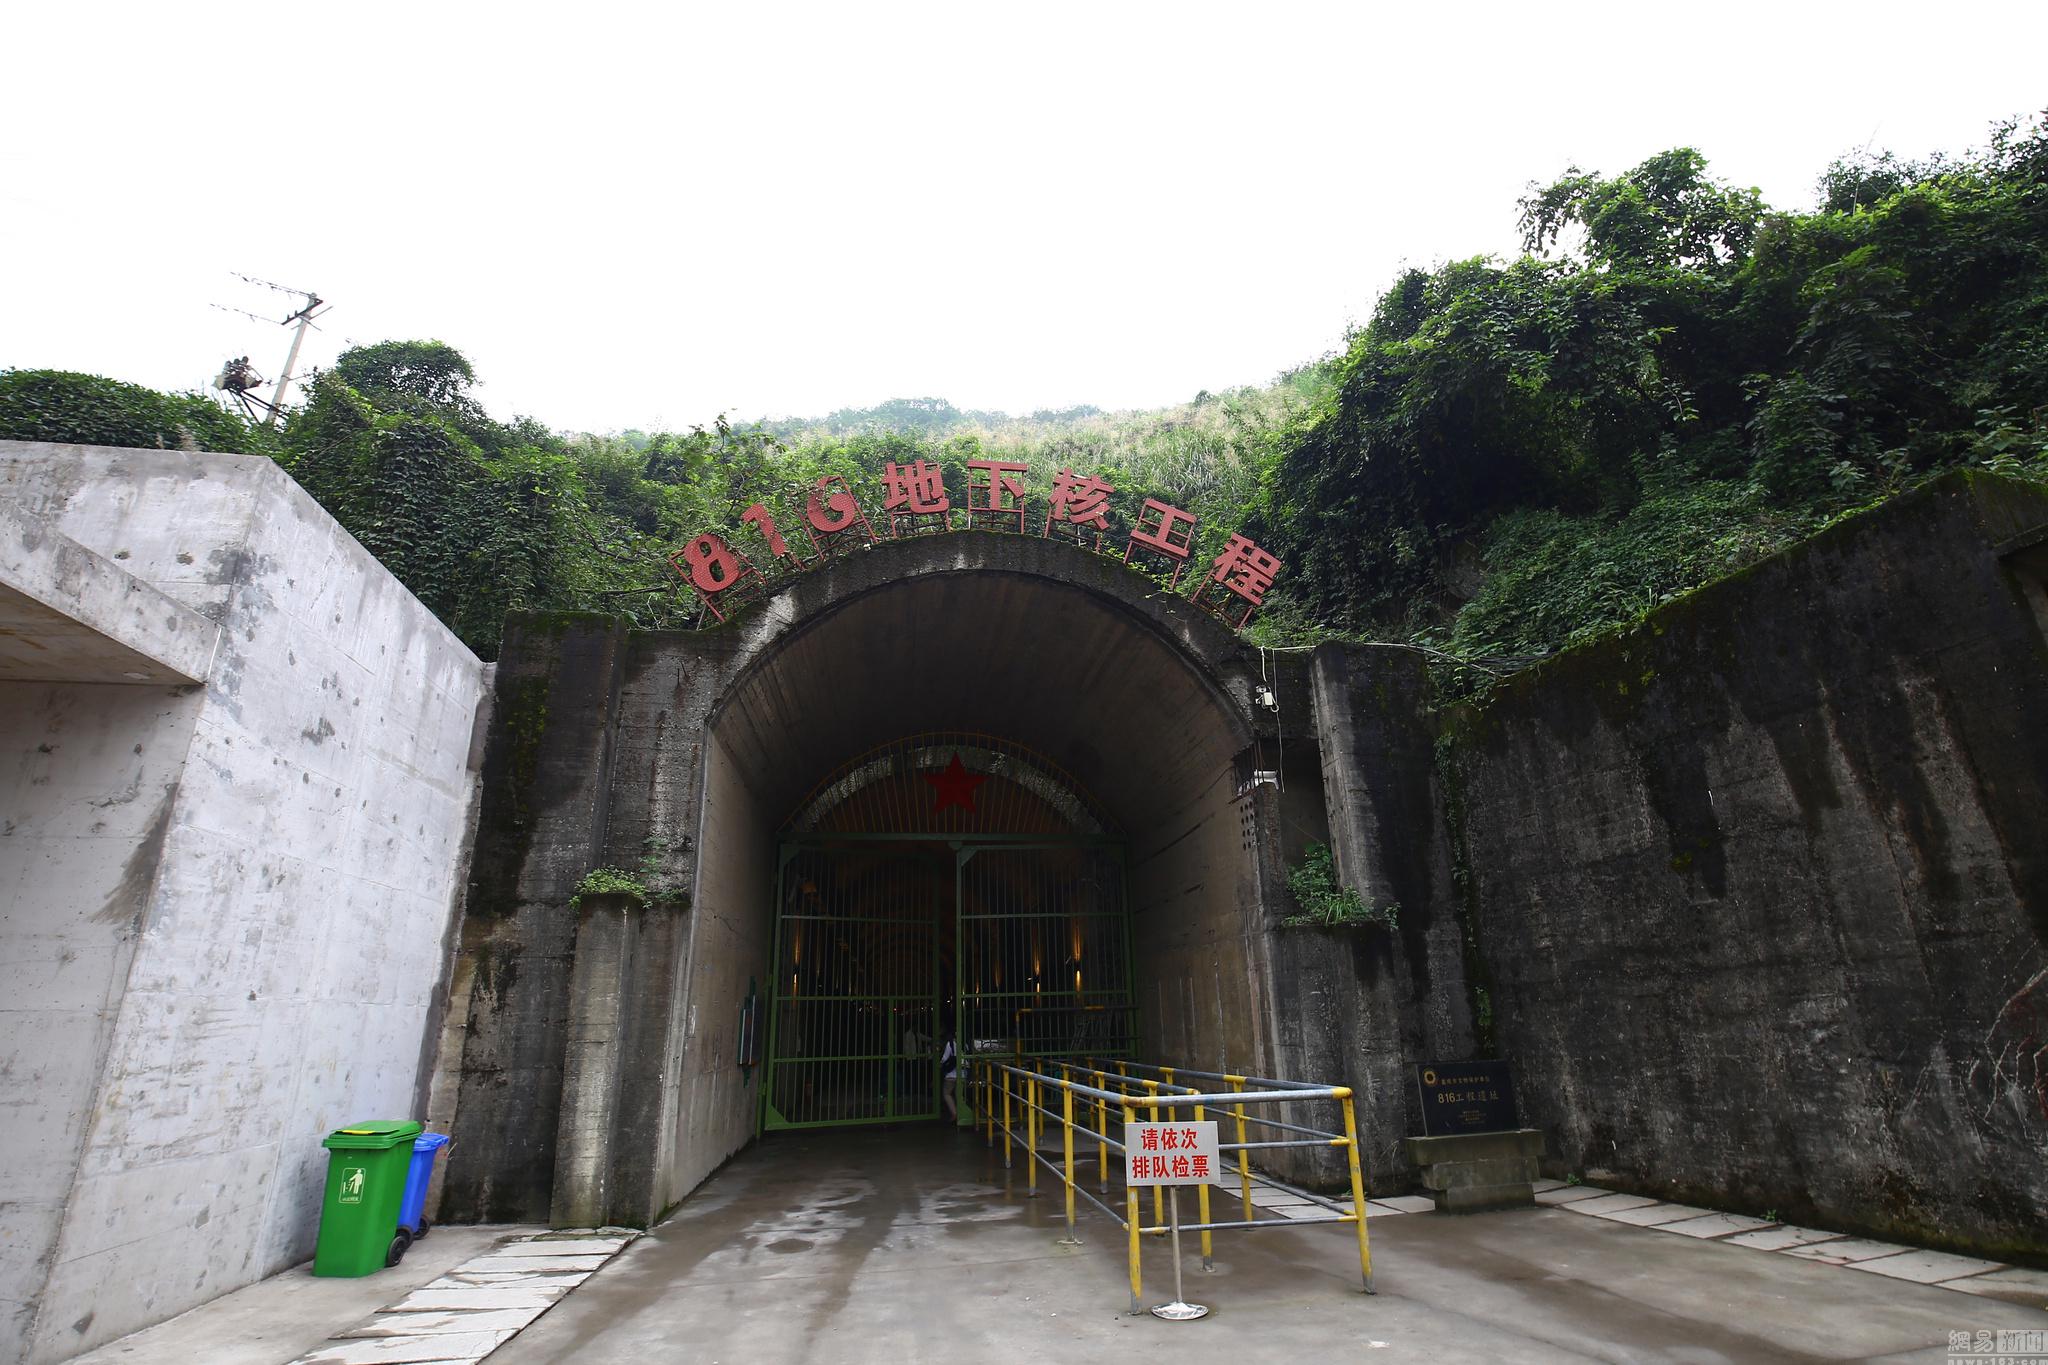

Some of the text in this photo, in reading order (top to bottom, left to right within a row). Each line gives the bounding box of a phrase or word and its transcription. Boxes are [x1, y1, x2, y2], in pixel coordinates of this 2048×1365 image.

[683, 460, 1282, 606] 816地下核工程
[1141, 1128, 1198, 1150] 请依次
[1132, 1155, 1209, 1178] 排队检票
